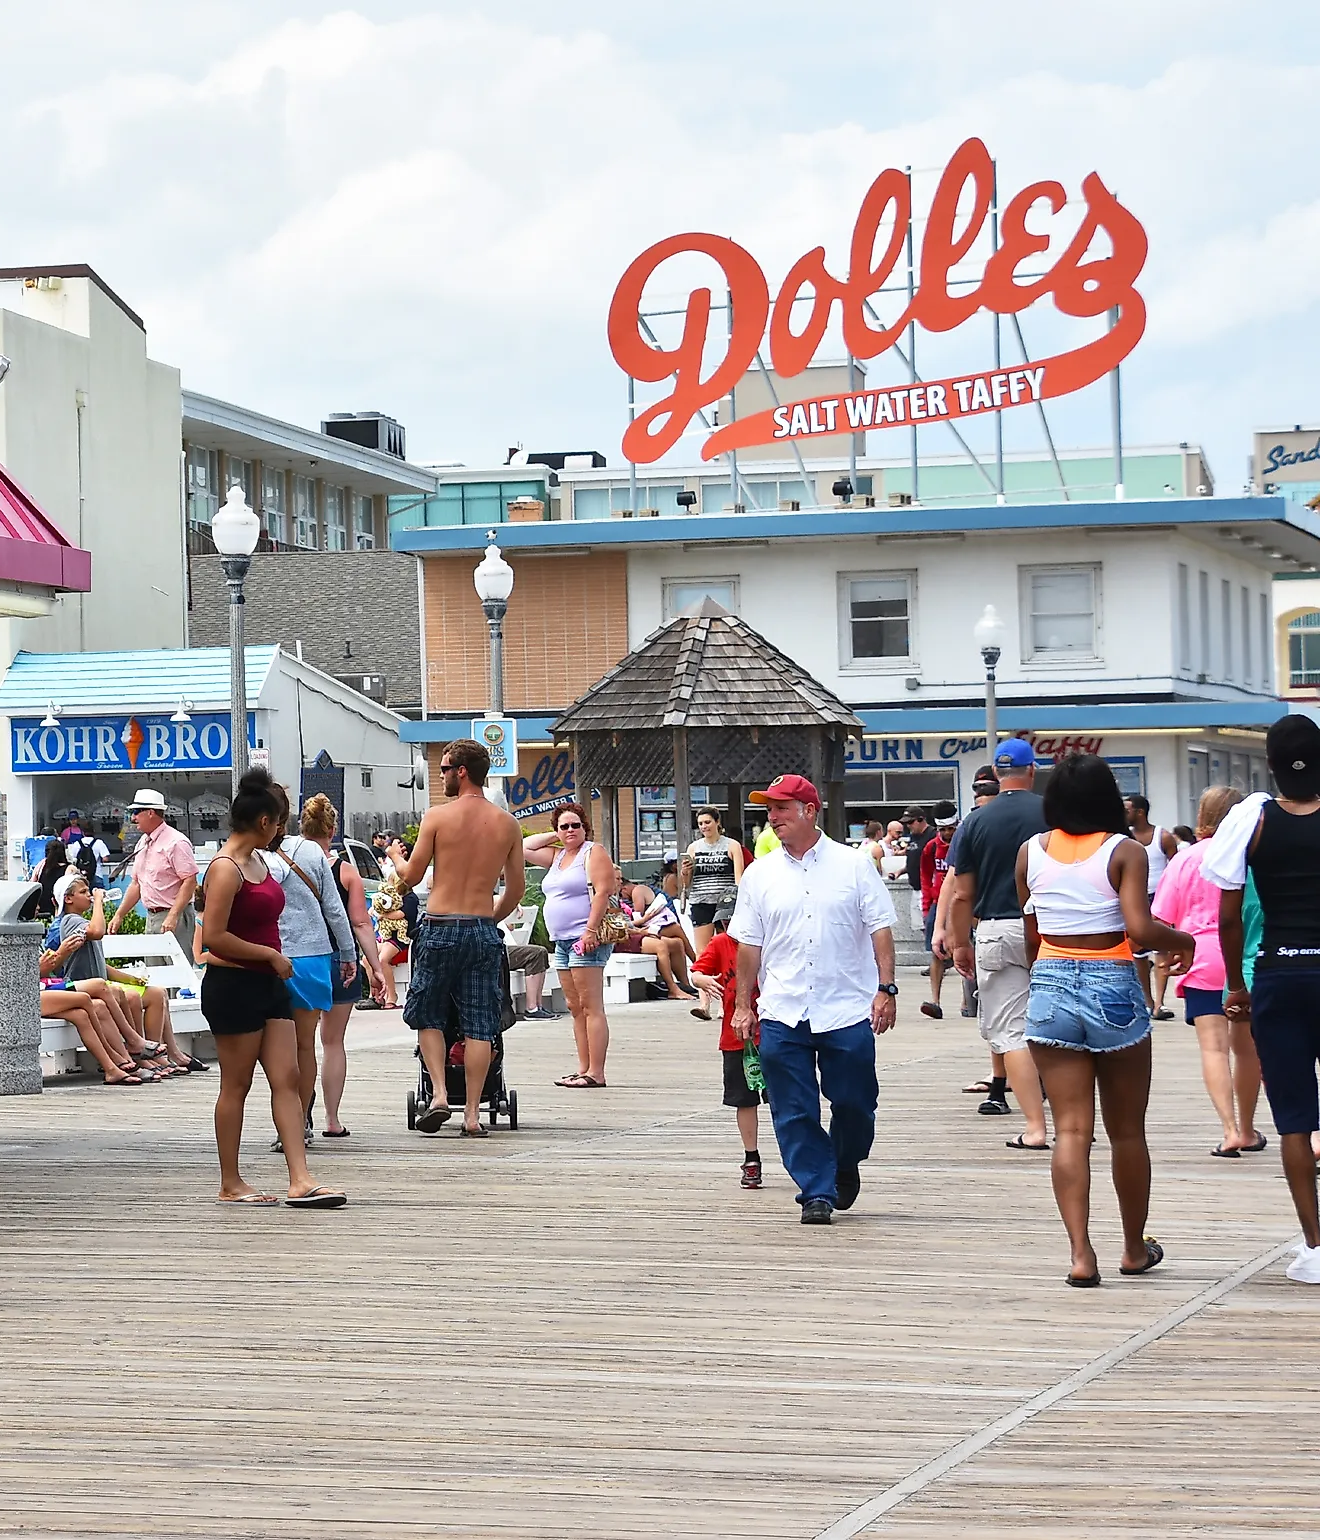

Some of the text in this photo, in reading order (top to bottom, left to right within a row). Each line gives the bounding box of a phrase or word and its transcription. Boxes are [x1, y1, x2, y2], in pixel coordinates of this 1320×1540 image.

[773, 366, 1046, 438] SALT WATER TAFFY
[13, 722, 232, 764] KOHR BRO
[96, 761, 123, 769] Frozen
[514, 807, 534, 820] SALT
